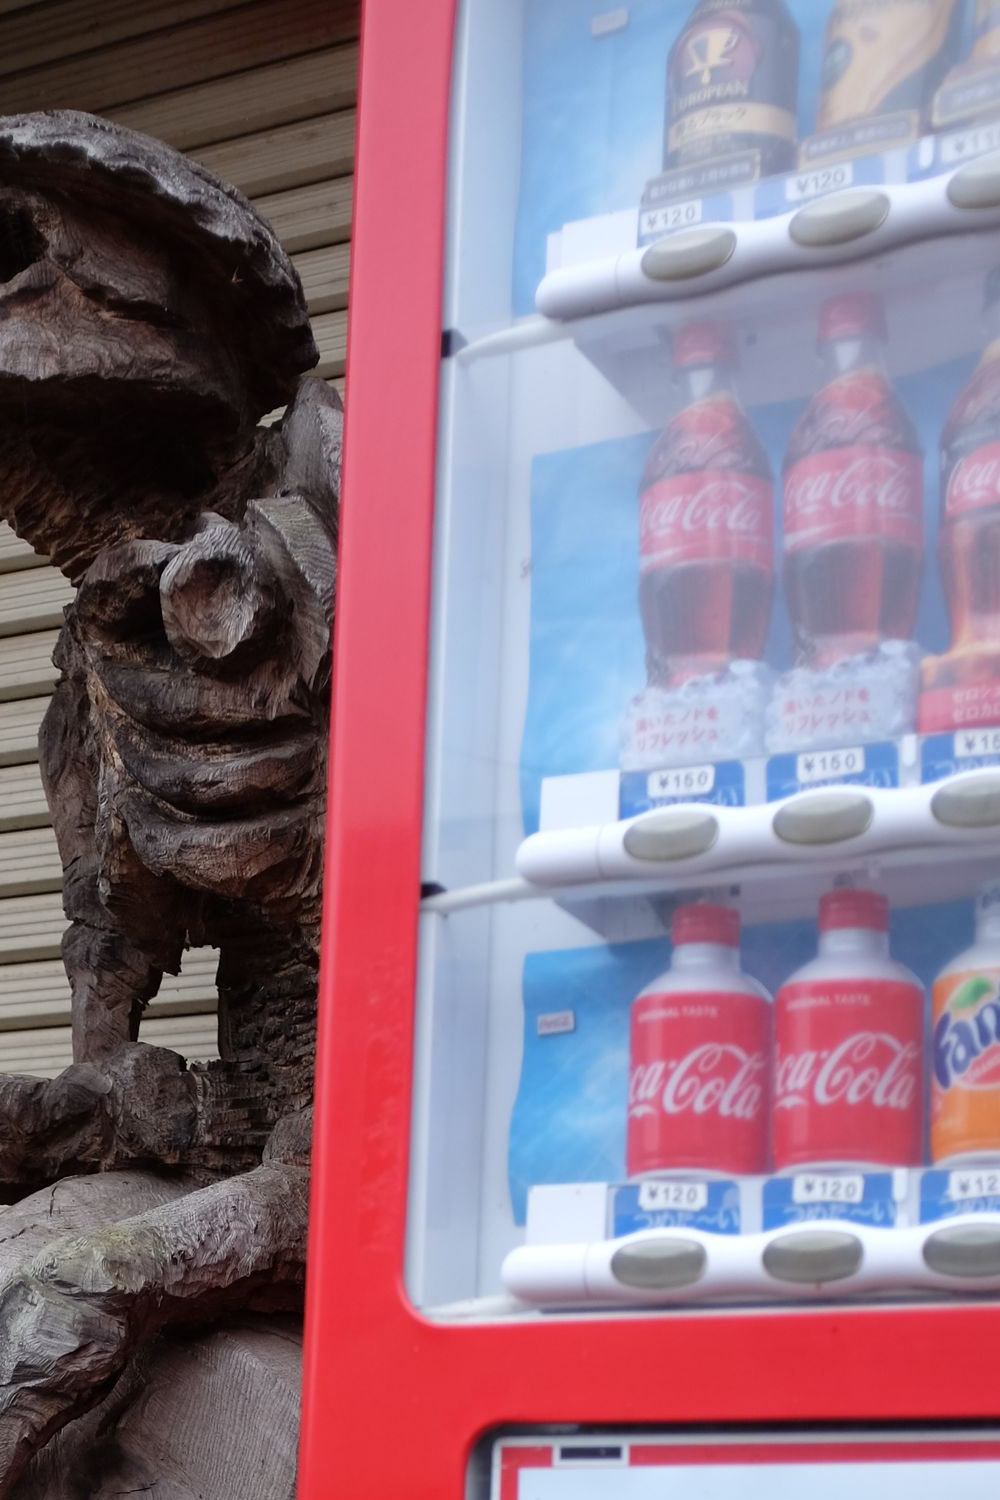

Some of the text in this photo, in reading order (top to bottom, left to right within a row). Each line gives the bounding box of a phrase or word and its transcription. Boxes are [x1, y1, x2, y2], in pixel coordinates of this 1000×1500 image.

[796, 167, 846, 193] ¥120
[647, 205, 696, 229] ¥120
[650, 1184, 697, 1204] ¥120
[804, 1177, 858, 1198] ¥120
